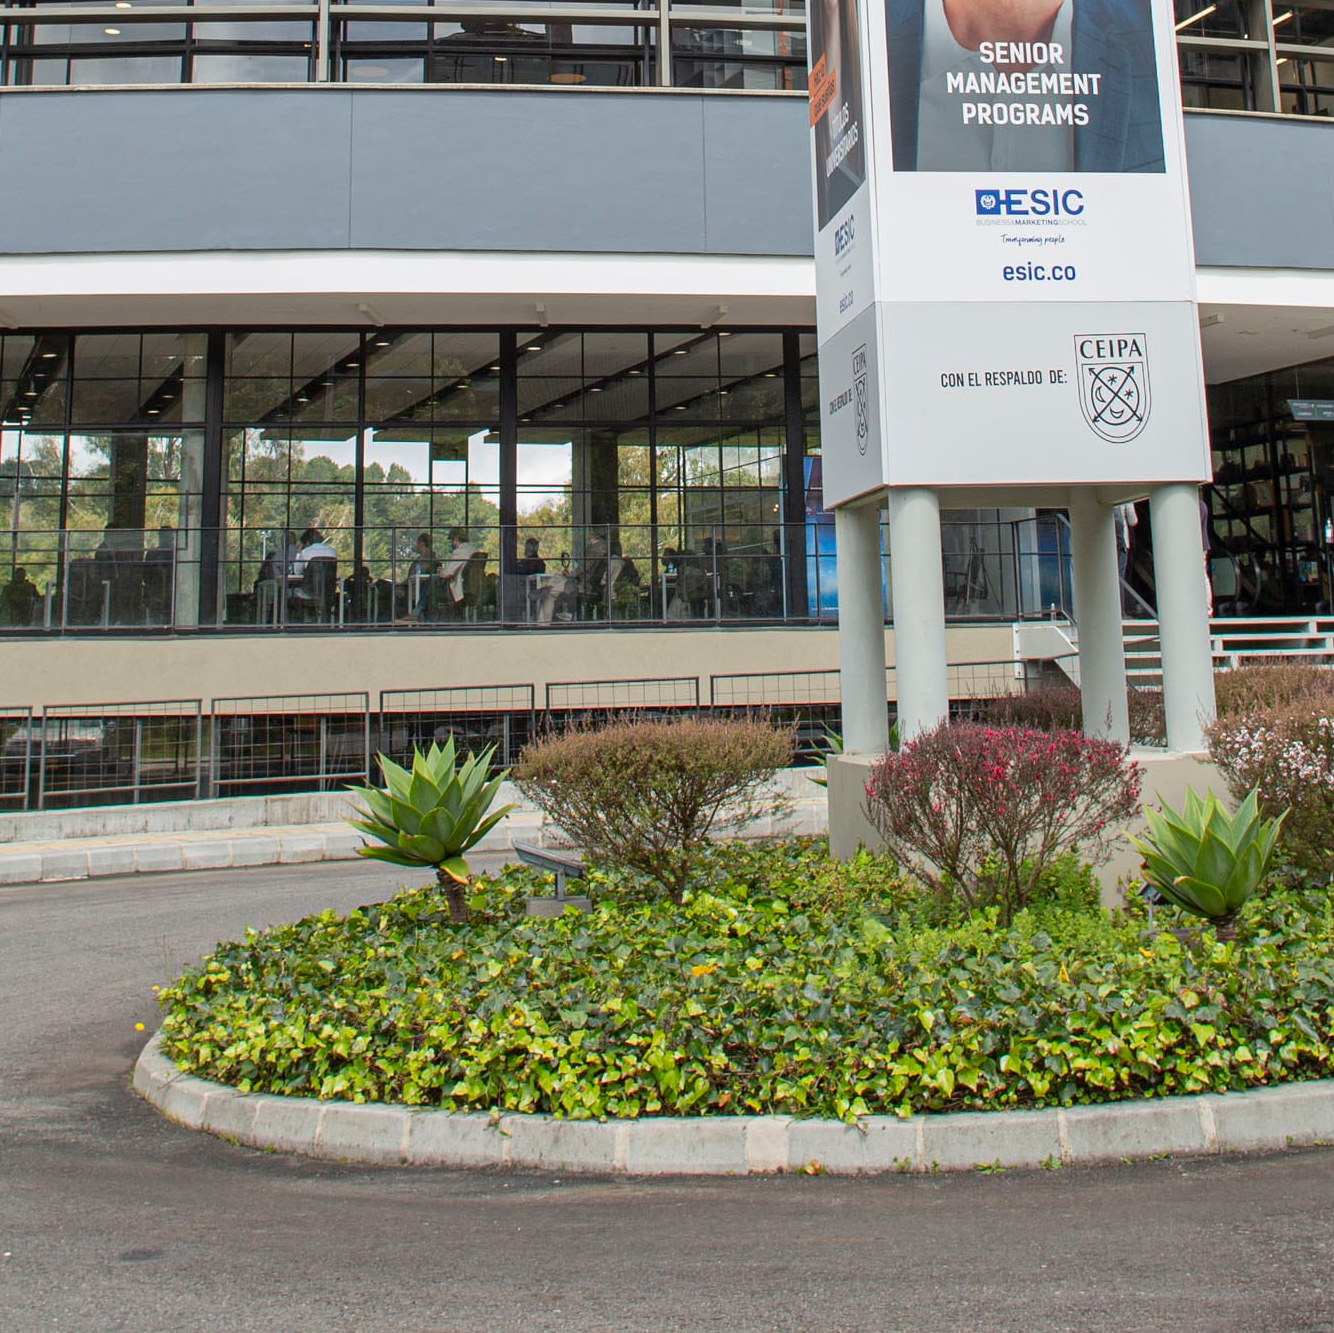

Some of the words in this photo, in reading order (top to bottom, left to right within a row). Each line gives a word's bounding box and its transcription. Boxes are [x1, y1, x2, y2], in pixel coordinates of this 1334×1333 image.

[979, 41, 1064, 65] SENIOR
[946, 71, 1102, 96] MANAGEMENT
[962, 102, 1090, 126] PROGRAMS
[1004, 188, 1085, 216] ESIC
[1044, 234, 1066, 247] people
[1002, 261, 1077, 281] esic.co
[1079, 338, 1143, 359] CEIPA
[940, 372, 966, 388] CON
[968, 371, 982, 387] EL
[985, 370, 1043, 387] RESPALDO
[1049, 369, 1068, 384] DE:
